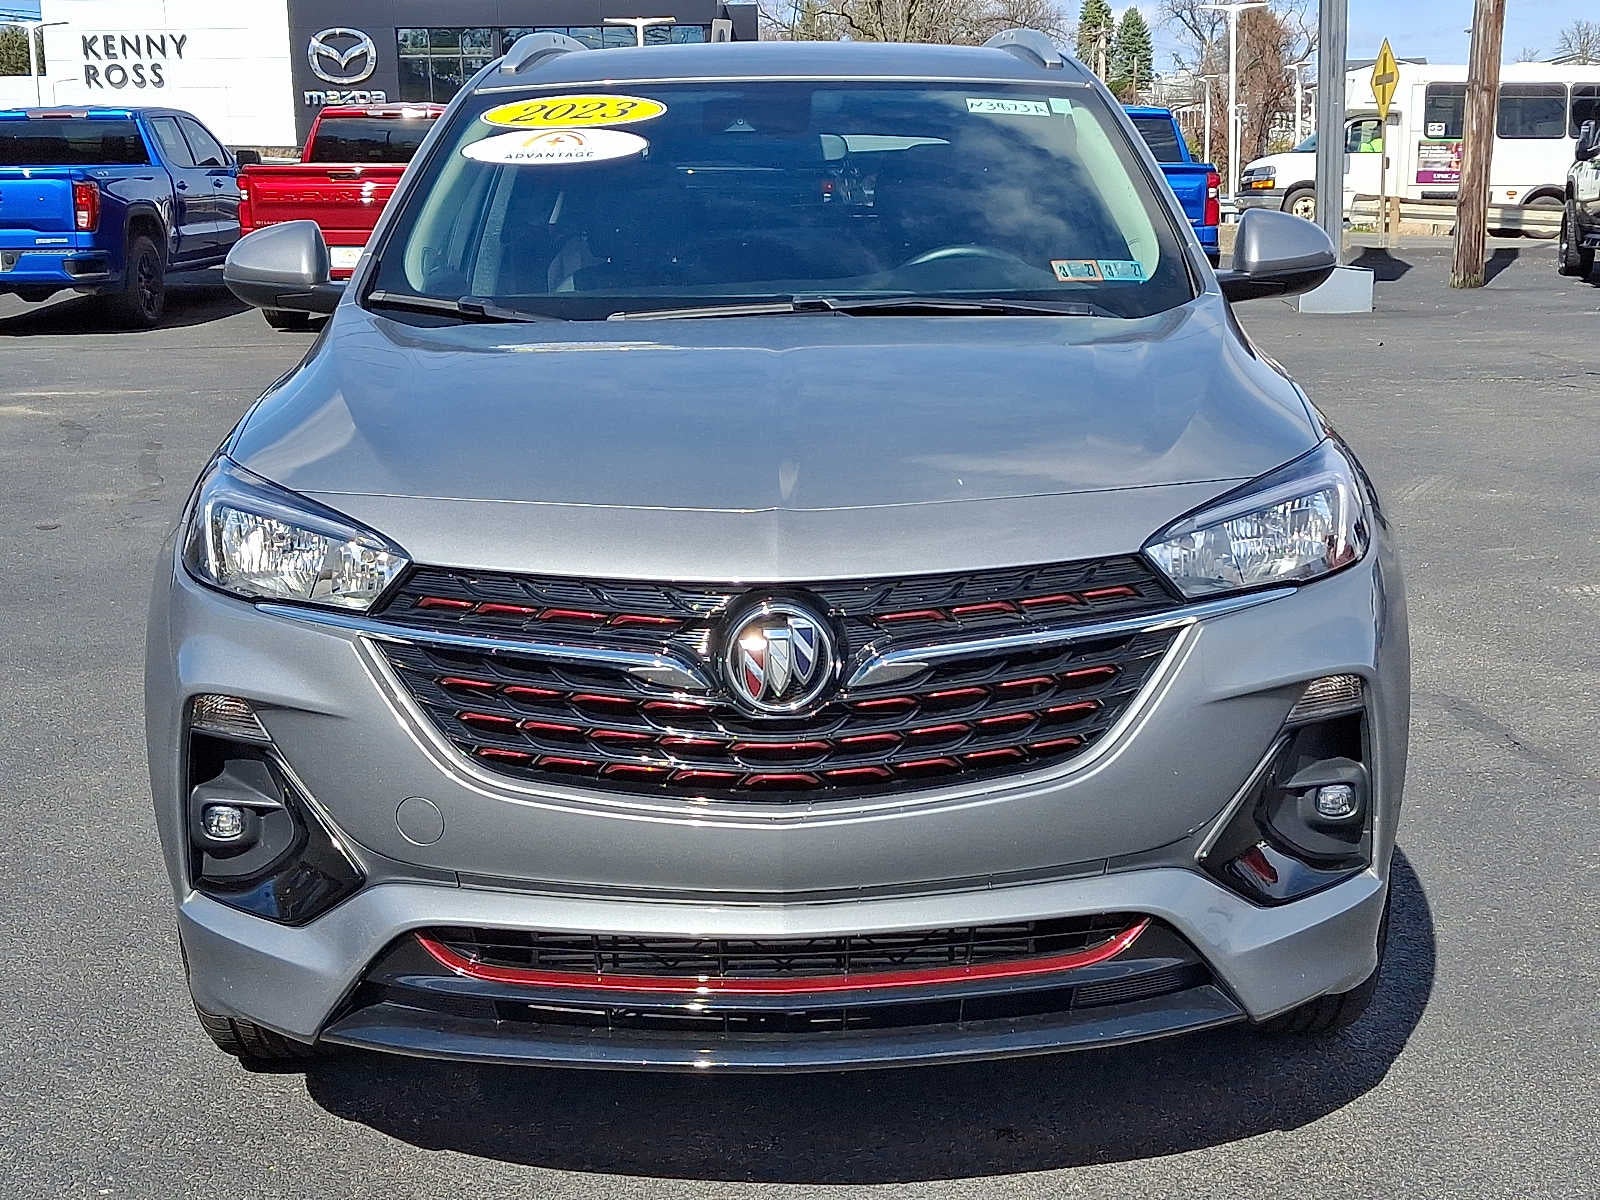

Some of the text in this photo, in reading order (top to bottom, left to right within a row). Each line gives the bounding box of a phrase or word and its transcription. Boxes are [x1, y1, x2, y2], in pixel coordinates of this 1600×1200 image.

[82, 34, 187, 60] KENNY
[84, 63, 165, 89] ROSS
[511, 101, 638, 122] 2023
[504, 151, 595, 159] ADVANTAGE
